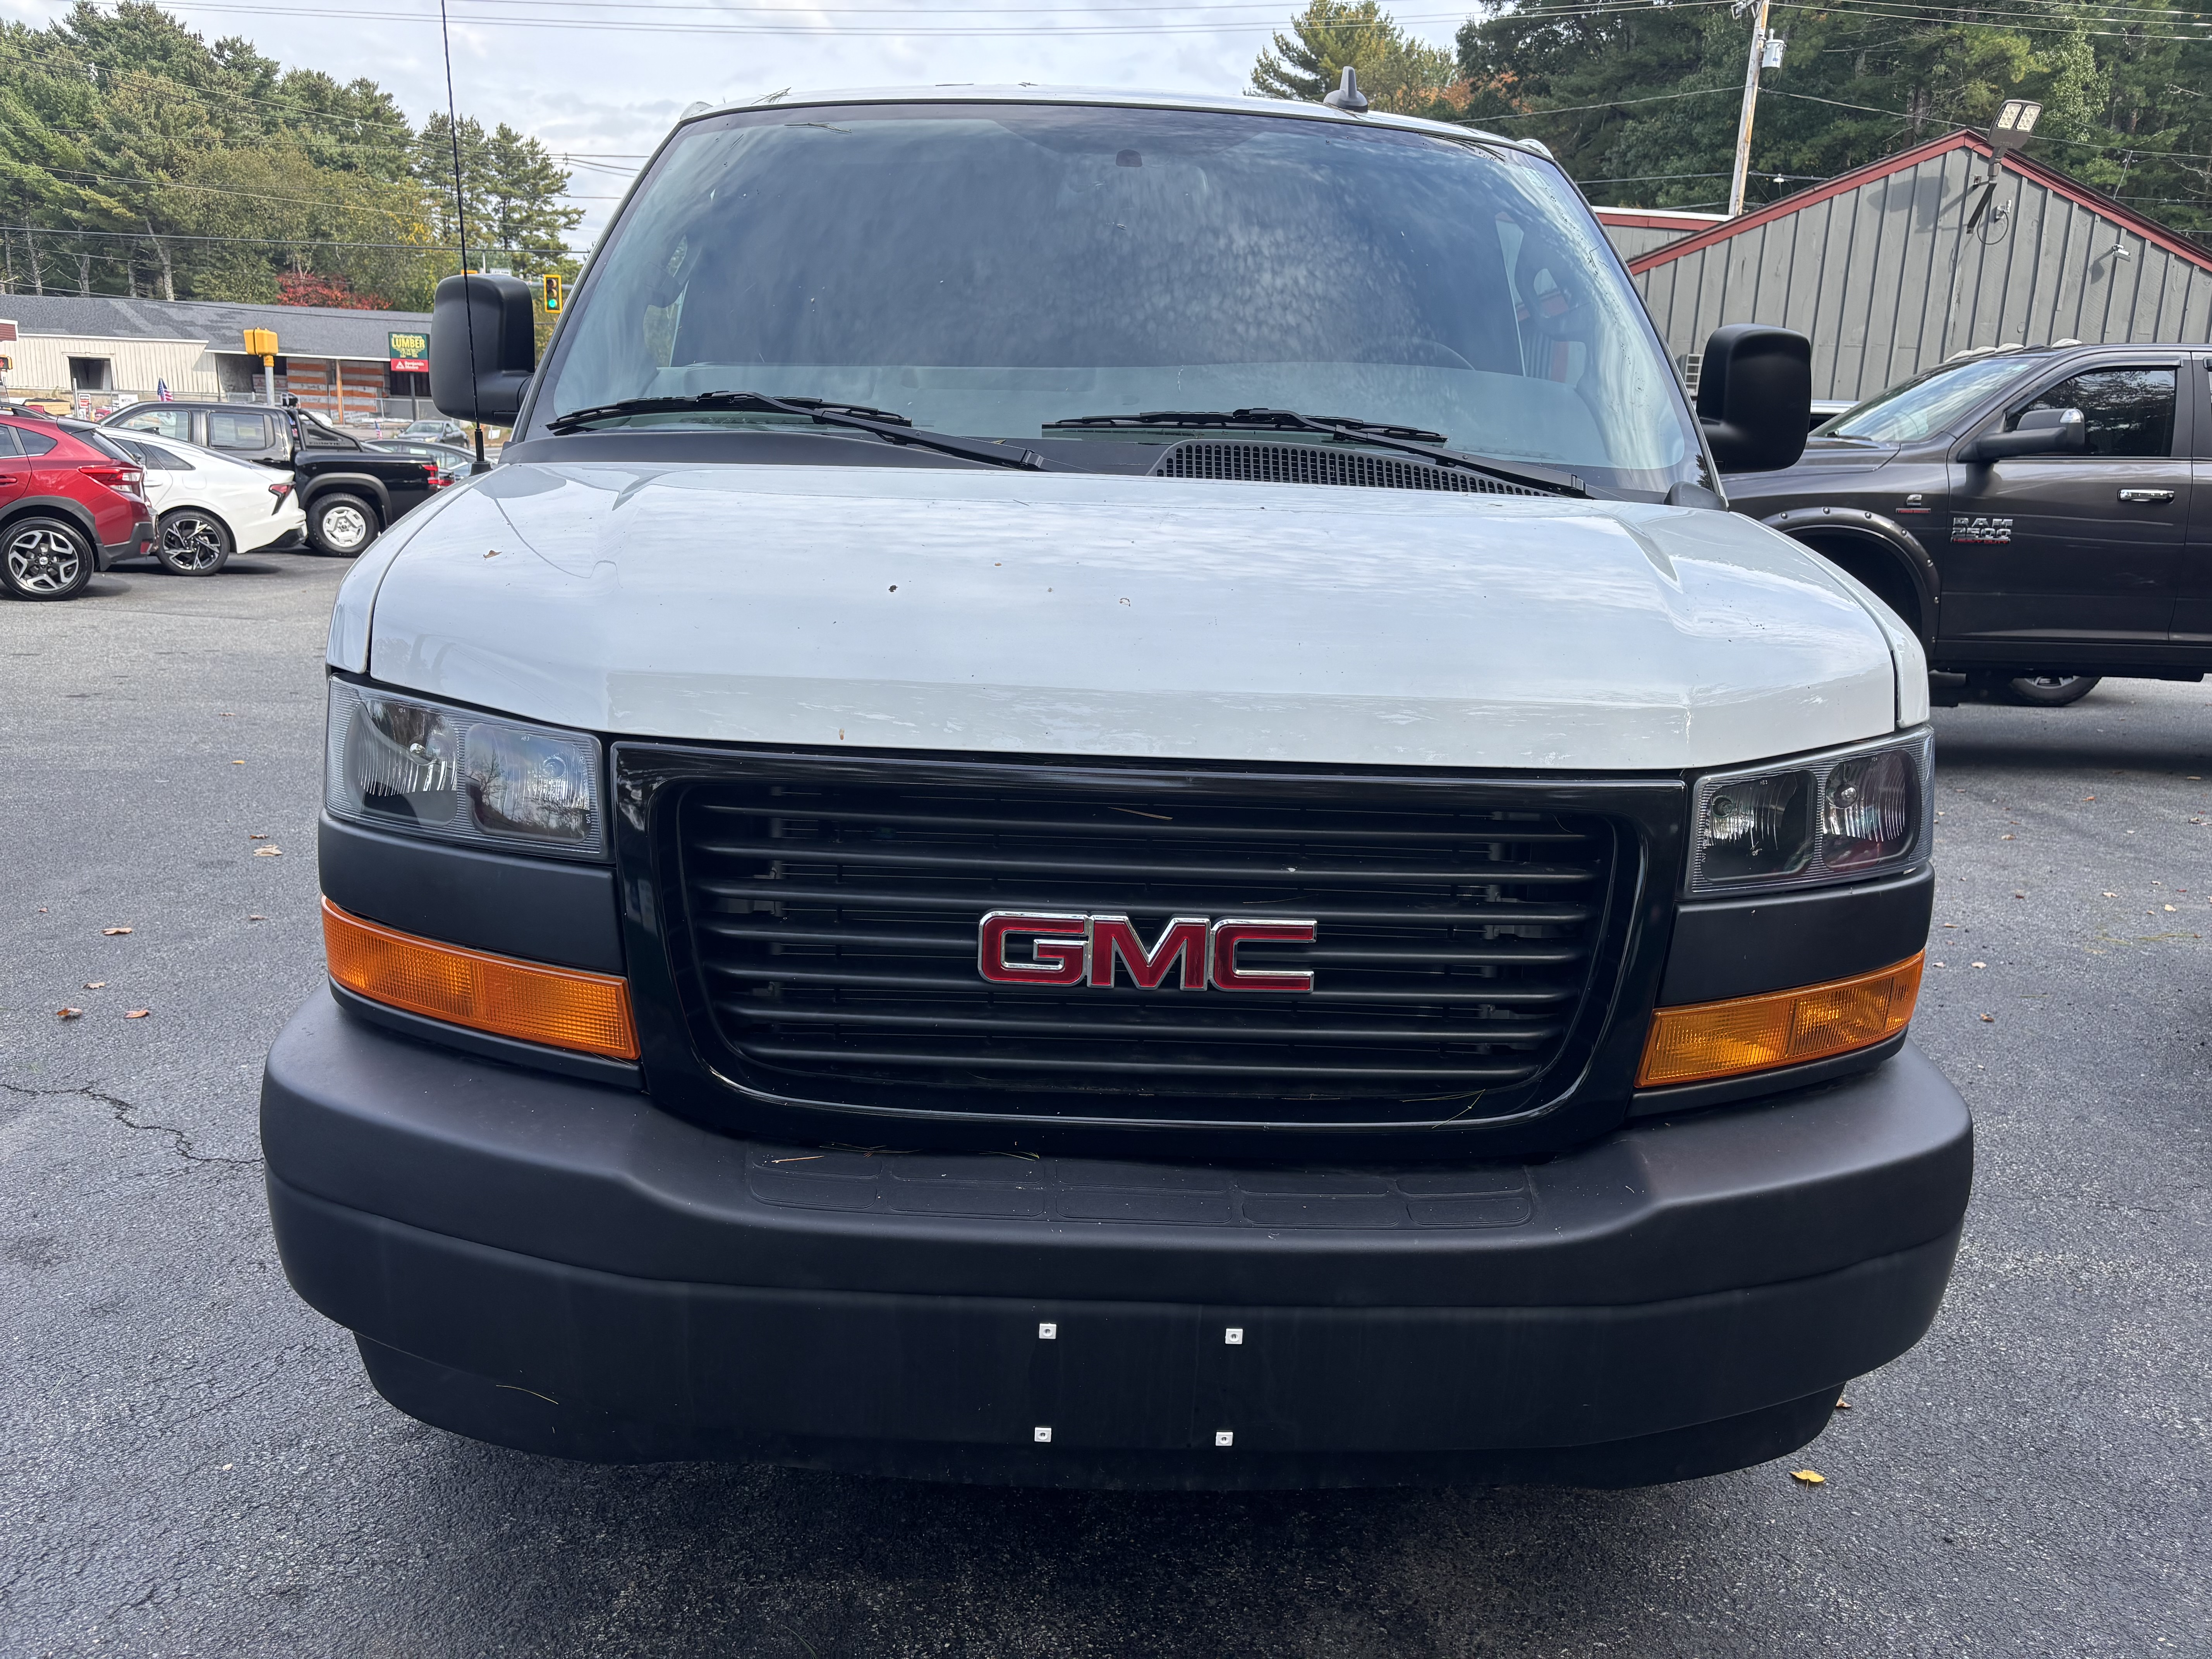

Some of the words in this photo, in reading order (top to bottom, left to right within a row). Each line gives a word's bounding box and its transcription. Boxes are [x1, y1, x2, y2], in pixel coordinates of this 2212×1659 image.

[392, 338, 425, 349] LUMBER
[1953, 517, 2013, 528] RAM
[1951, 527, 2011, 539] 2500
[977, 908, 1317, 993] GMC
